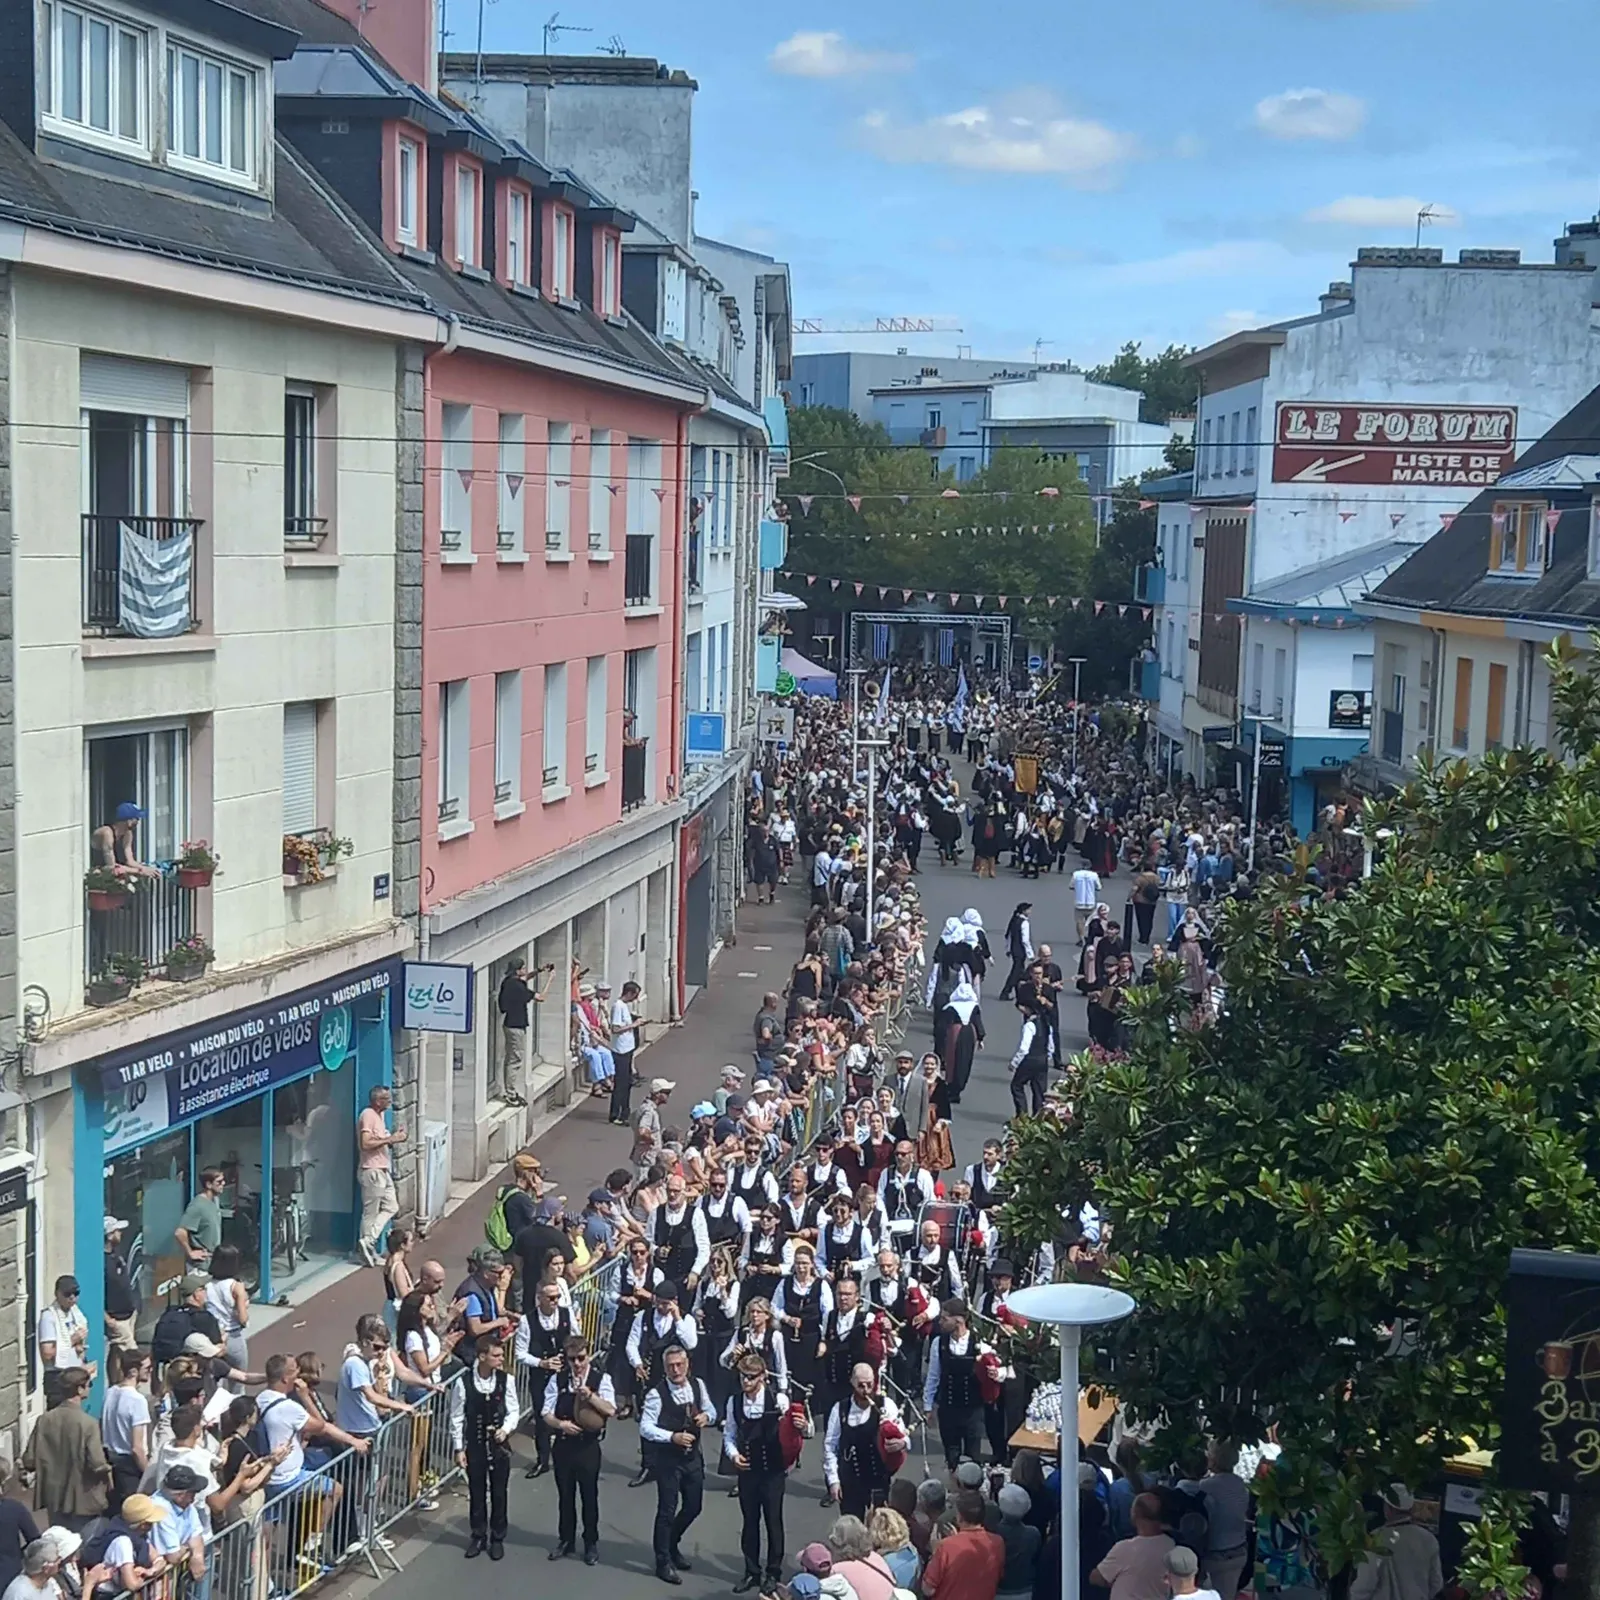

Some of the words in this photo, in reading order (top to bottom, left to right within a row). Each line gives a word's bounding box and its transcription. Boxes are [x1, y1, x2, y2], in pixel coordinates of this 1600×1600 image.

[1285, 410, 1341, 440] LE
[1353, 411, 1509, 443] FORUM
[1392, 469, 1502, 483] MARIAGE
[1395, 454, 1462, 468] LISTE
[1469, 455, 1500, 469] DE
[119, 1066, 131, 1082] TI
[132, 1061, 146, 1079] AR
[147, 1051, 173, 1072] VELO
[190, 1031, 227, 1058] MAISON
[227, 1026, 240, 1044] DU
[241, 1019, 264, 1038] VÉLO
[278, 1010, 287, 1025] TI
[288, 1006, 299, 1022] AR
[299, 999, 320, 1017] VELO
[332, 983, 361, 1005] MAISON
[361, 978, 371, 994] DU
[180, 1044, 249, 1090] Location
[252, 1035, 271, 1062] de
[185, 1084, 229, 1112] assistance
[230, 1068, 269, 1093] électrique
